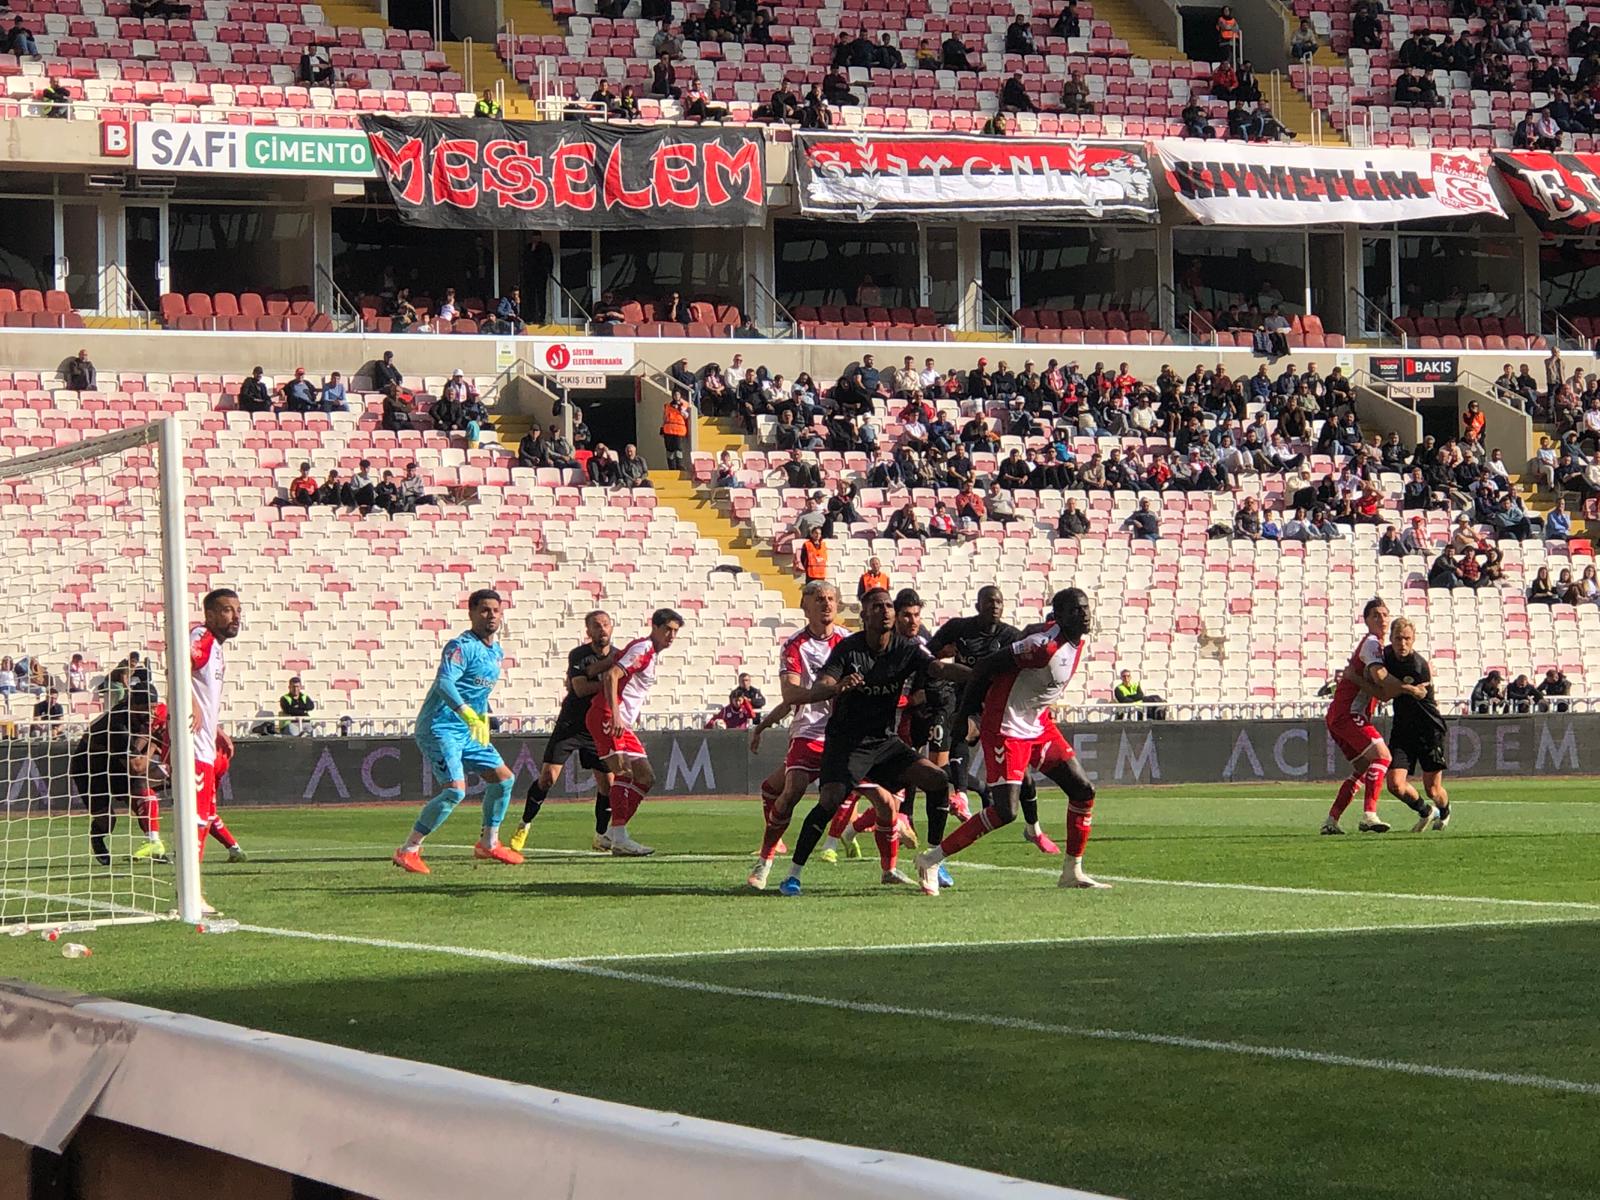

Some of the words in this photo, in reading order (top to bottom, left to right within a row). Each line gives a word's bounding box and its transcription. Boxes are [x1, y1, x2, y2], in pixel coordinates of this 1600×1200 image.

[107, 125, 127, 150] B
[254, 136, 366, 165] ÇİMENTO
[586, 376, 603, 384] EXIT
[1416, 386, 1431, 394] EXIT
